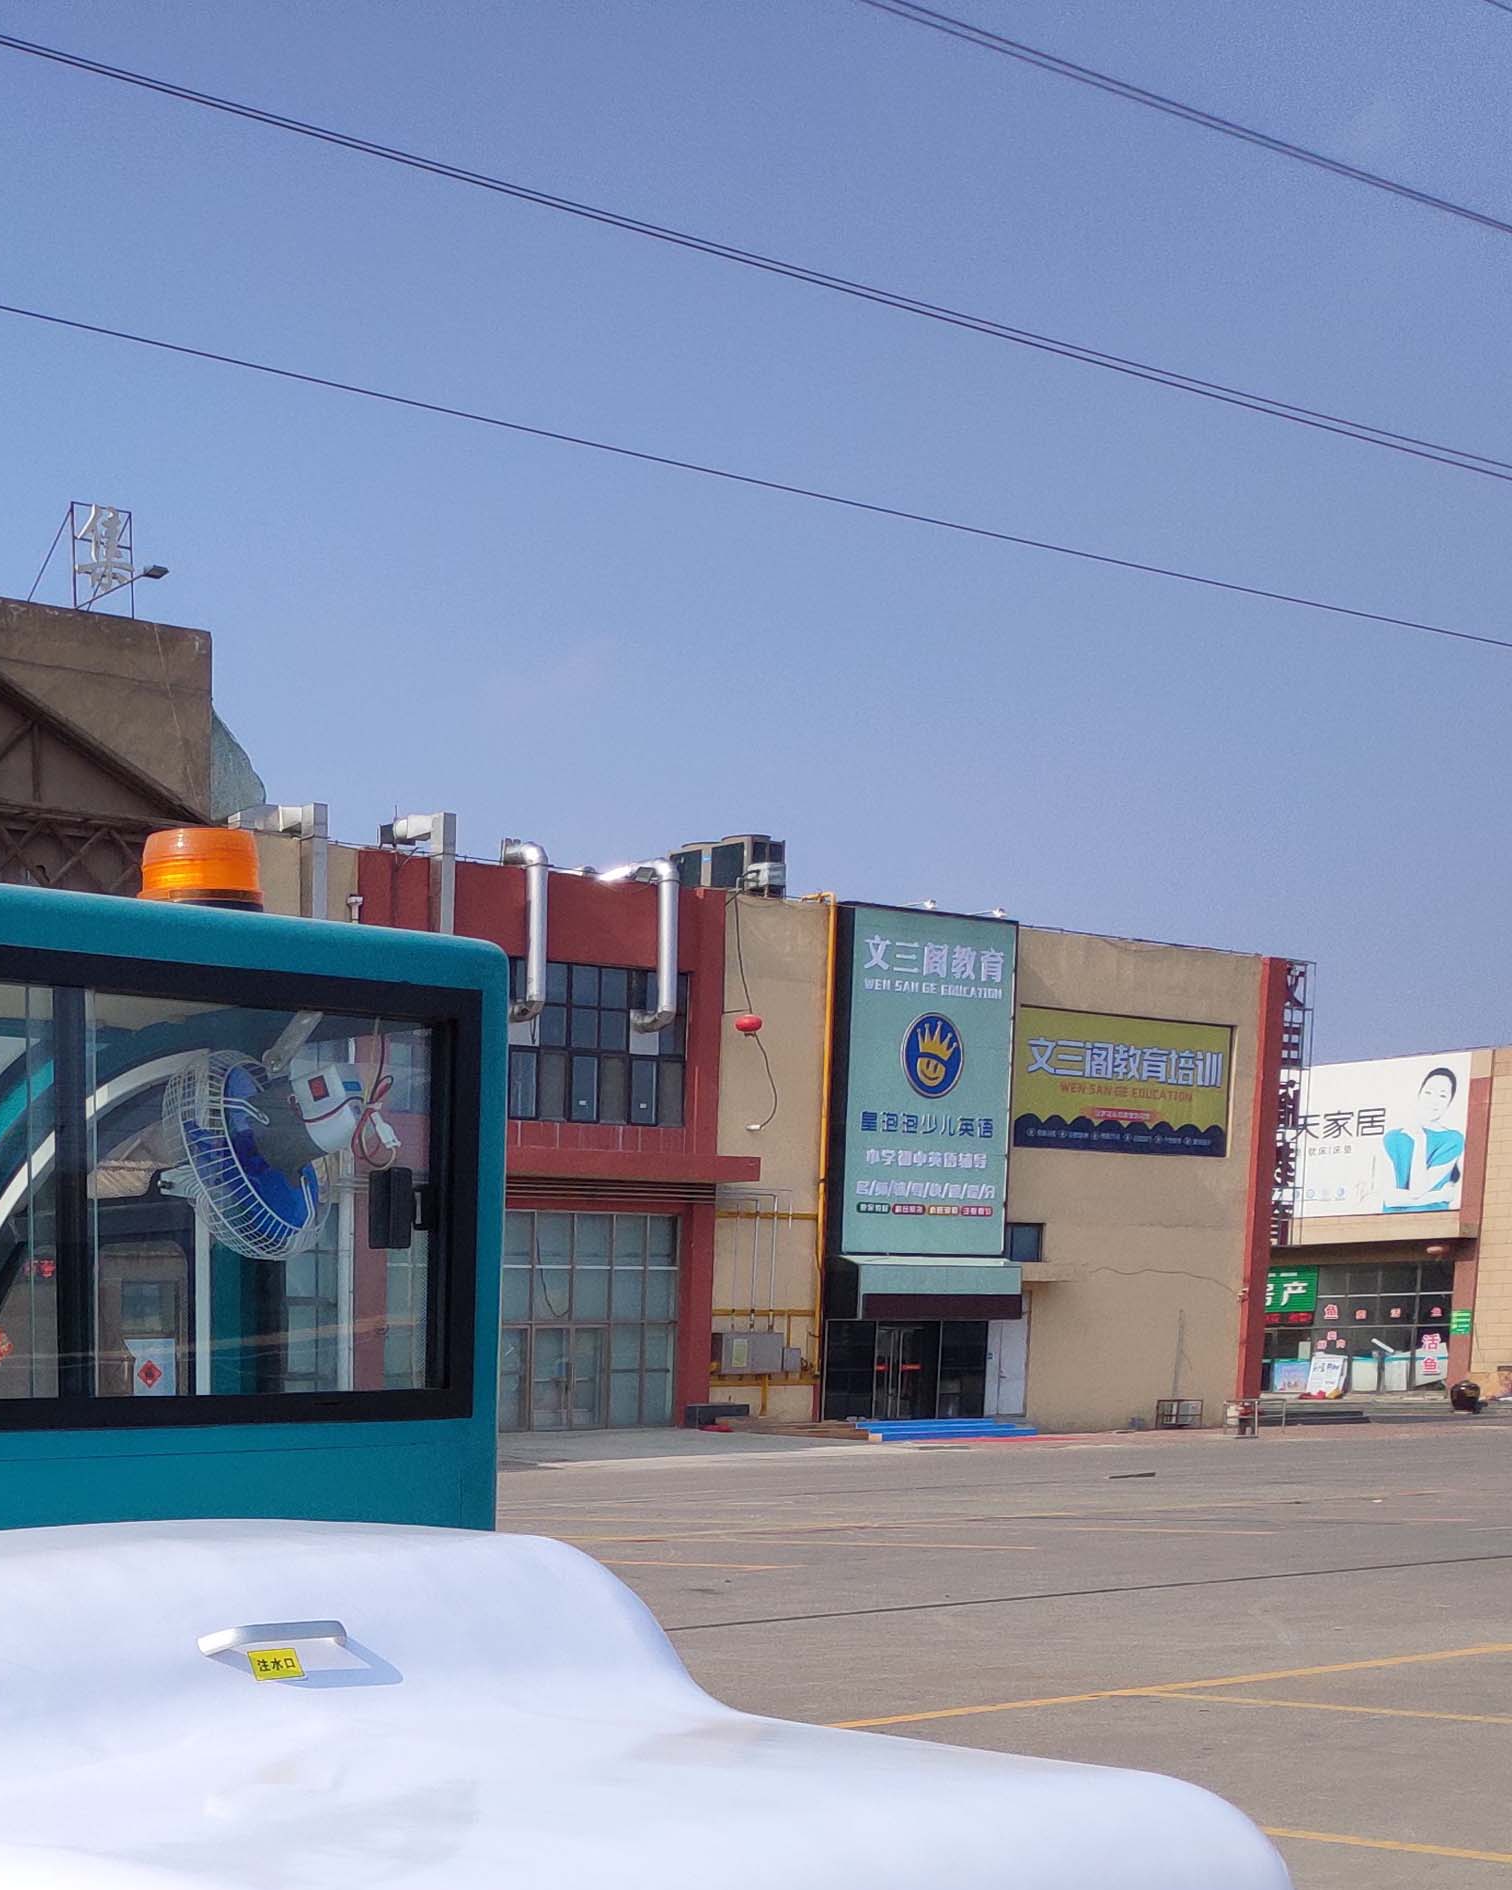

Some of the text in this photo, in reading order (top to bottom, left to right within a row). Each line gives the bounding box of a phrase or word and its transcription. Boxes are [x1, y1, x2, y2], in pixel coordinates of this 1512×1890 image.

[864, 934, 1005, 983] 文三阁教育
[864, 977, 1003, 1000] WEN SAN GE EDUCATION
[1026, 1037, 1224, 1088] 文三阁教育培训
[1059, 1080, 1087, 1095] WEN
[1088, 1083, 1112, 1096] SAN
[1131, 1088, 1193, 1102] EDUCATION
[257, 1658, 296, 1672] 注水口
